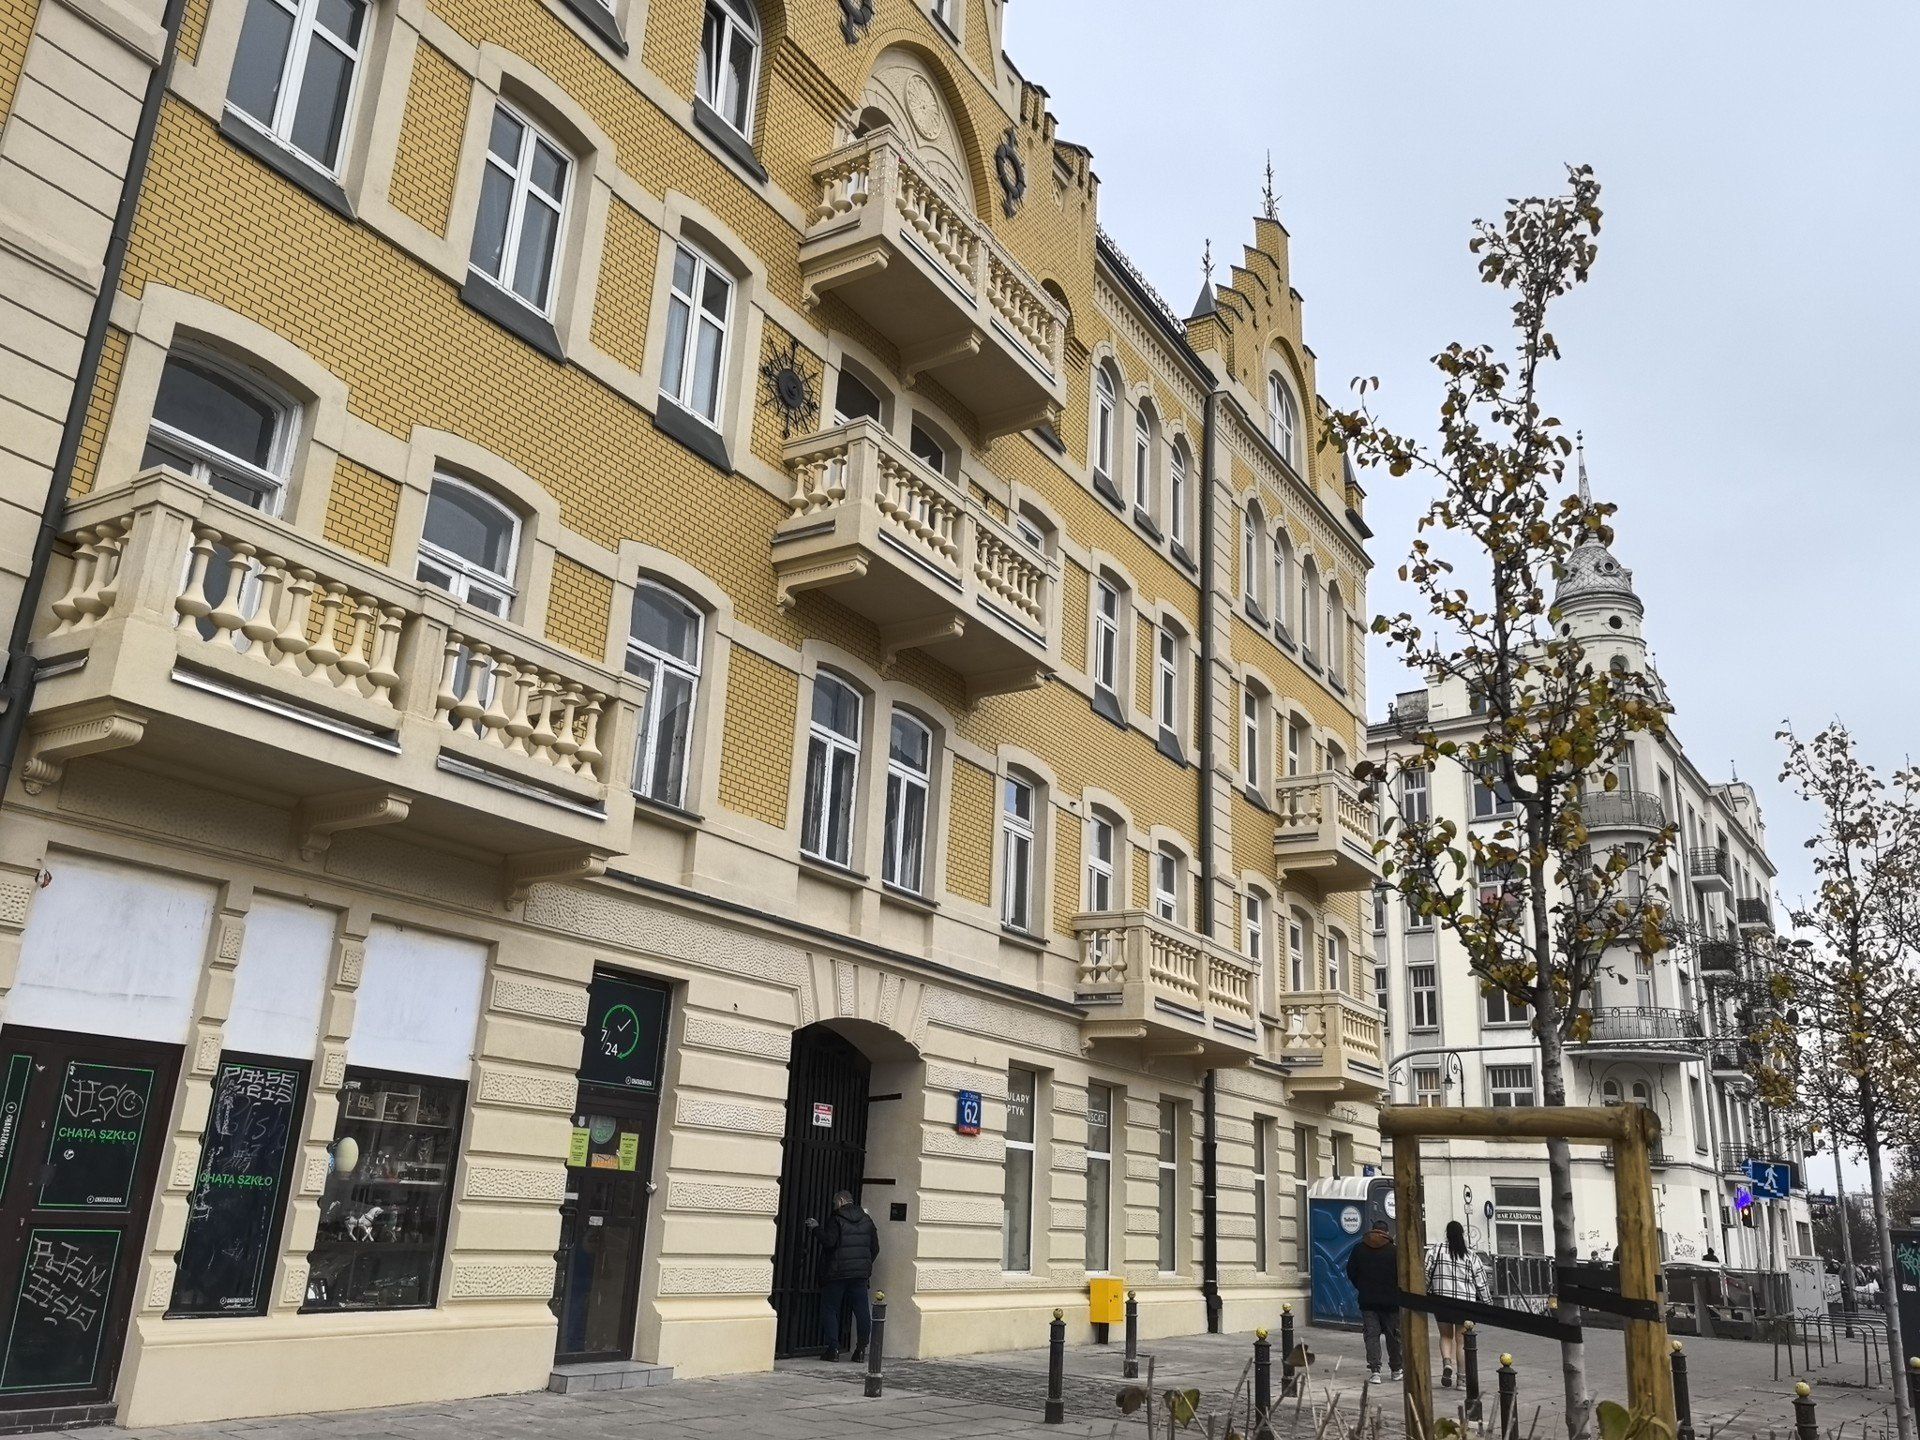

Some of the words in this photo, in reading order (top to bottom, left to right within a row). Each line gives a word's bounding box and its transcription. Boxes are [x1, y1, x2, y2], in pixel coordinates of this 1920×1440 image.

[964, 1101, 979, 1124] 62
[58, 1127, 97, 1140] CHATA
[99, 1129, 137, 1141] SZKŁO
[200, 1172, 235, 1185] CHATA
[237, 1174, 273, 1187] SZKŁO
